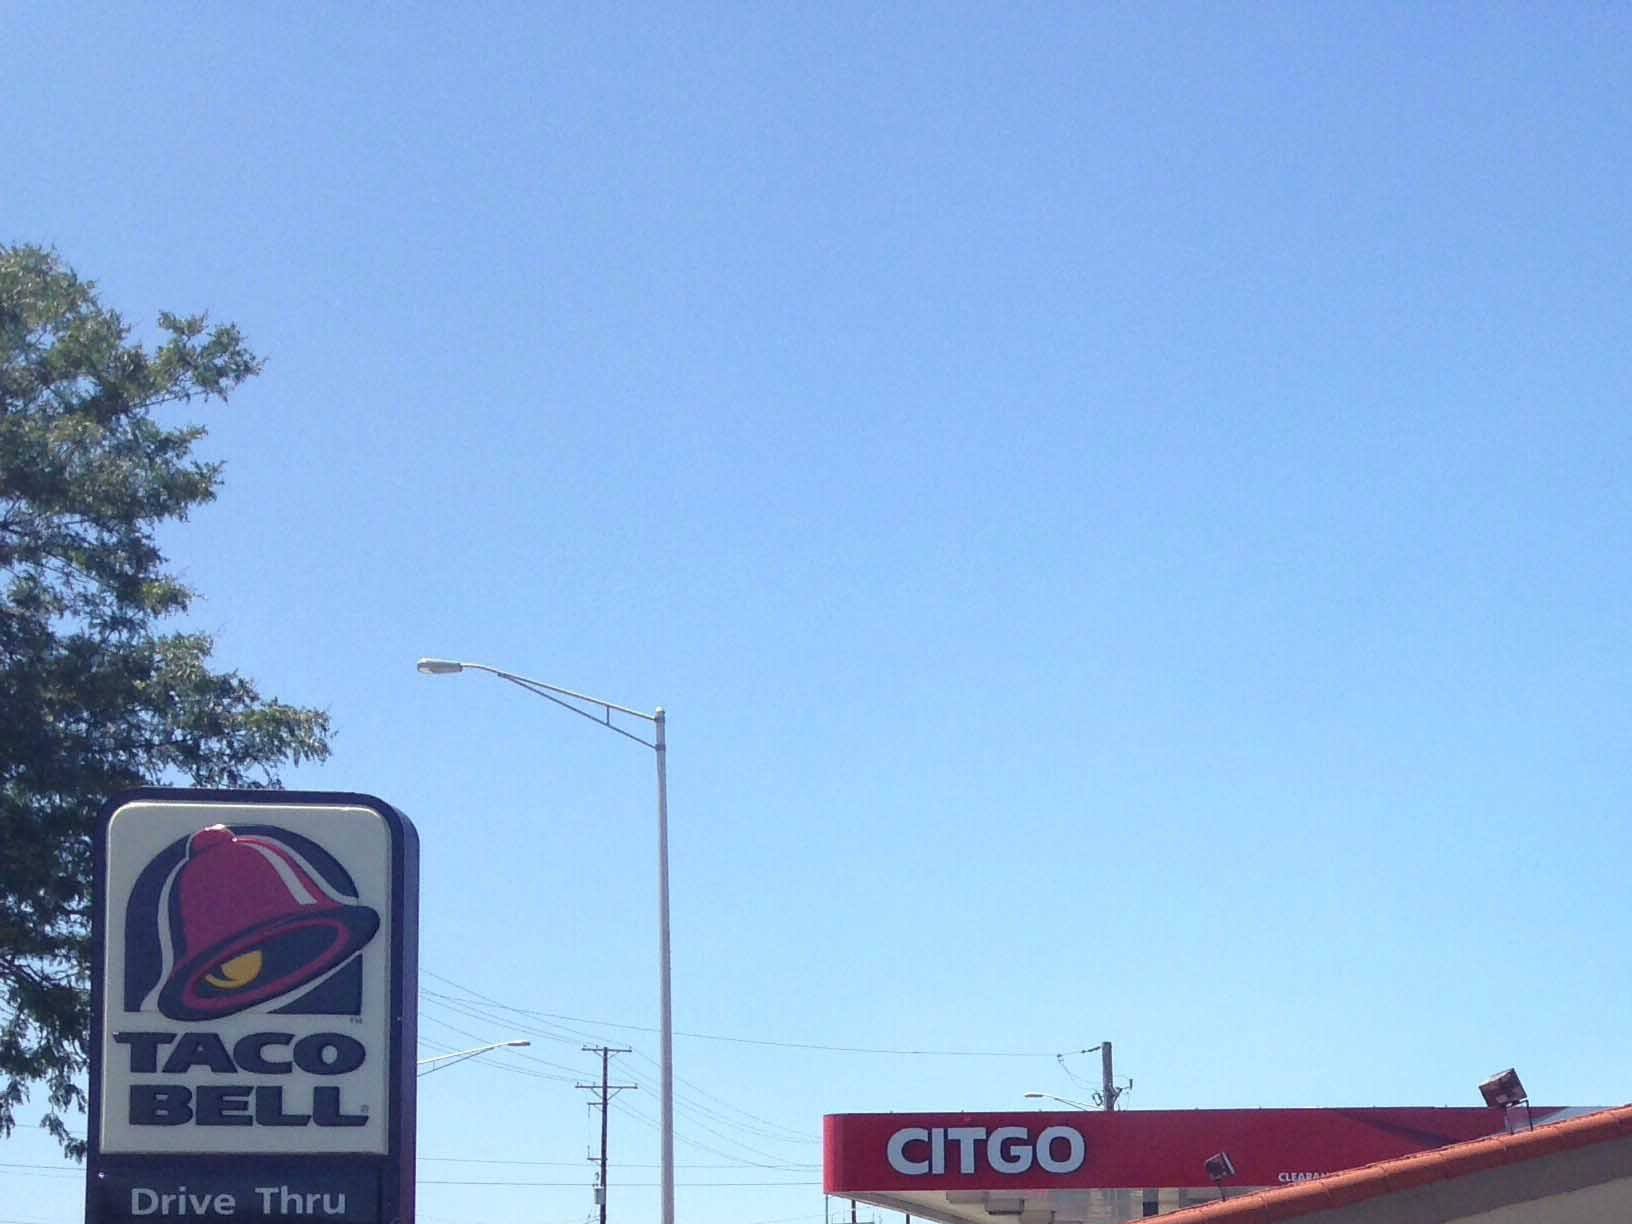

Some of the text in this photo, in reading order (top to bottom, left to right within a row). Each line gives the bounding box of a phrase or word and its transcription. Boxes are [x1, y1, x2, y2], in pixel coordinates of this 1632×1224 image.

[113, 1031, 366, 1075] TACO
[129, 1084, 370, 1127] BELL
[887, 1127, 1086, 1175] CITGO
[131, 1186, 346, 1216] Drive Thru
